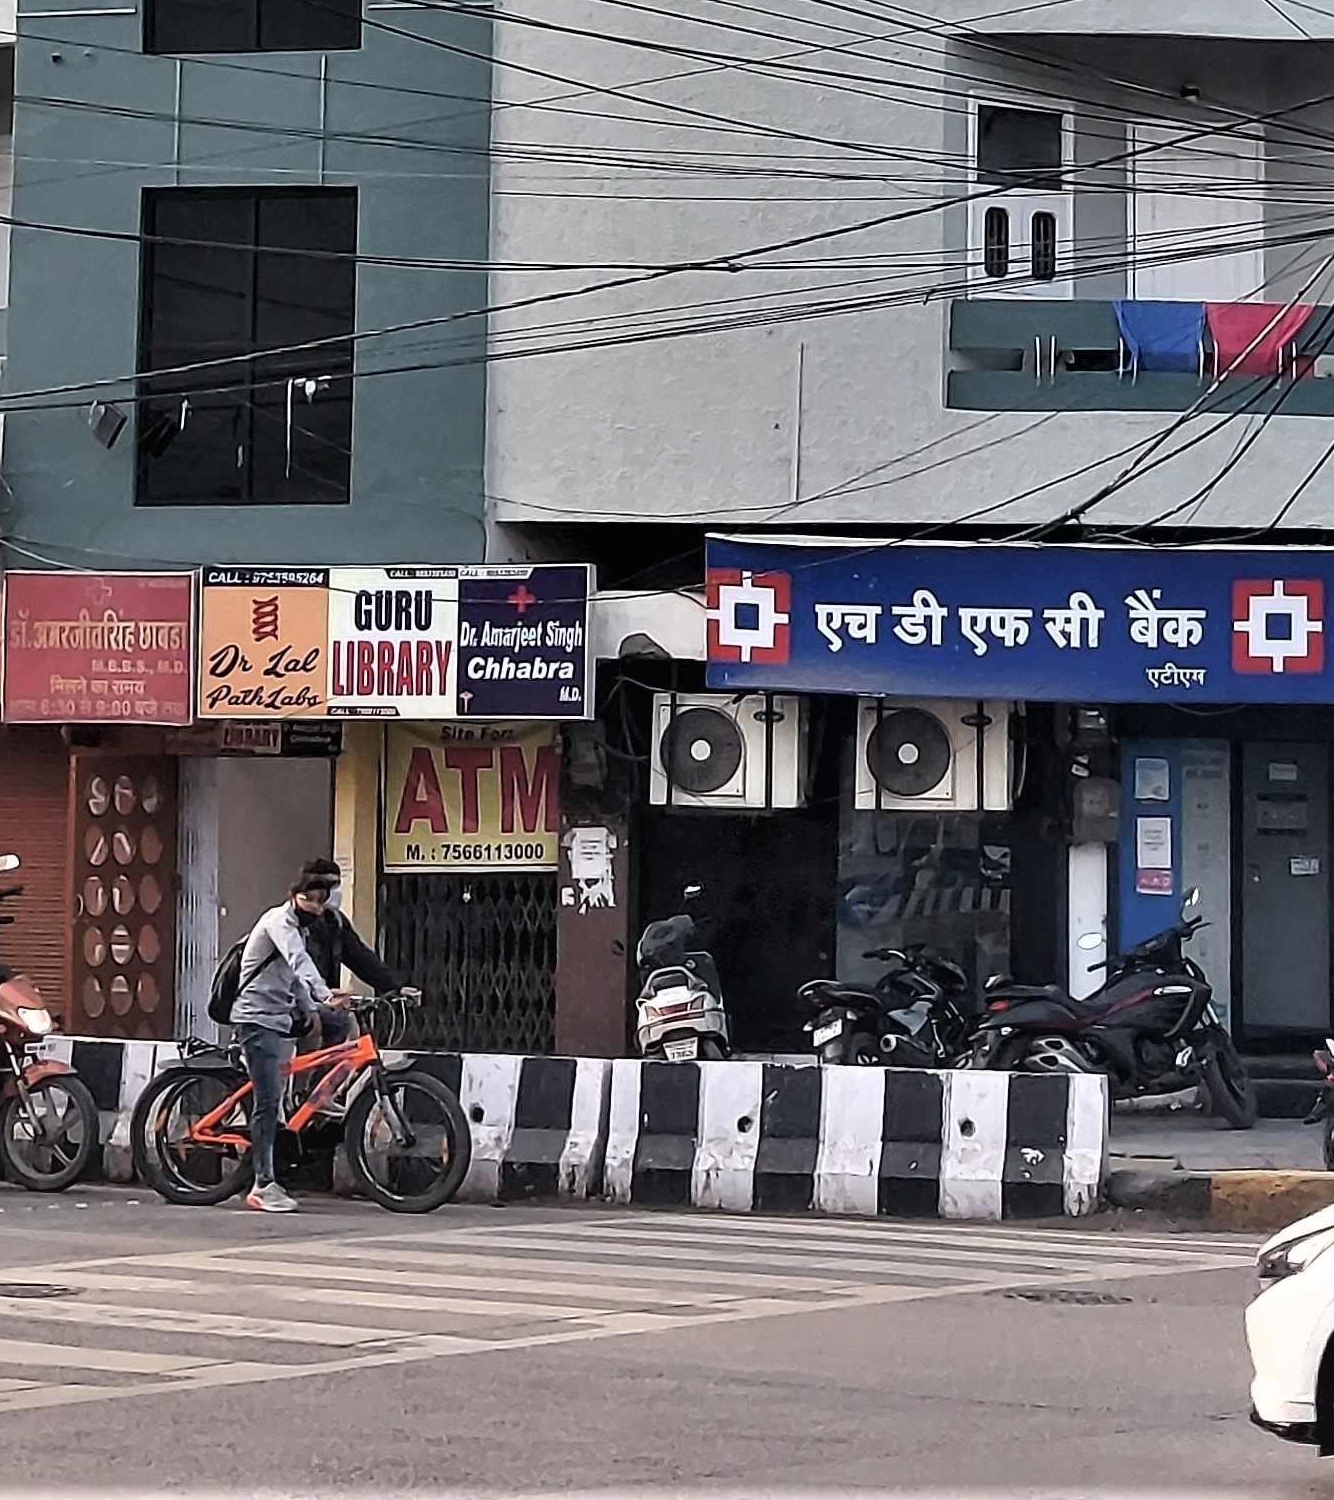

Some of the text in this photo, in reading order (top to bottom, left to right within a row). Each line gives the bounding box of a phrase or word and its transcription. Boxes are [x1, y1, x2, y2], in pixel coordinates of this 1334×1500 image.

[208, 571, 242, 584] CALL
[353, 589, 434, 632] GURU
[815, 588, 1207, 656] एच डी एफ सी बैंक
[481, 620, 543, 653] Amarjeet
[546, 619, 583, 653] Singh
[208, 643, 320, 678] Dr Lal
[332, 638, 453, 697] LIBRARY
[467, 656, 574, 681] Chhabra
[1146, 662, 1207, 688] एटीएम
[559, 685, 582, 702] M.D.
[393, 746, 559, 834] ATM
[440, 843, 544, 861] 7566113000
